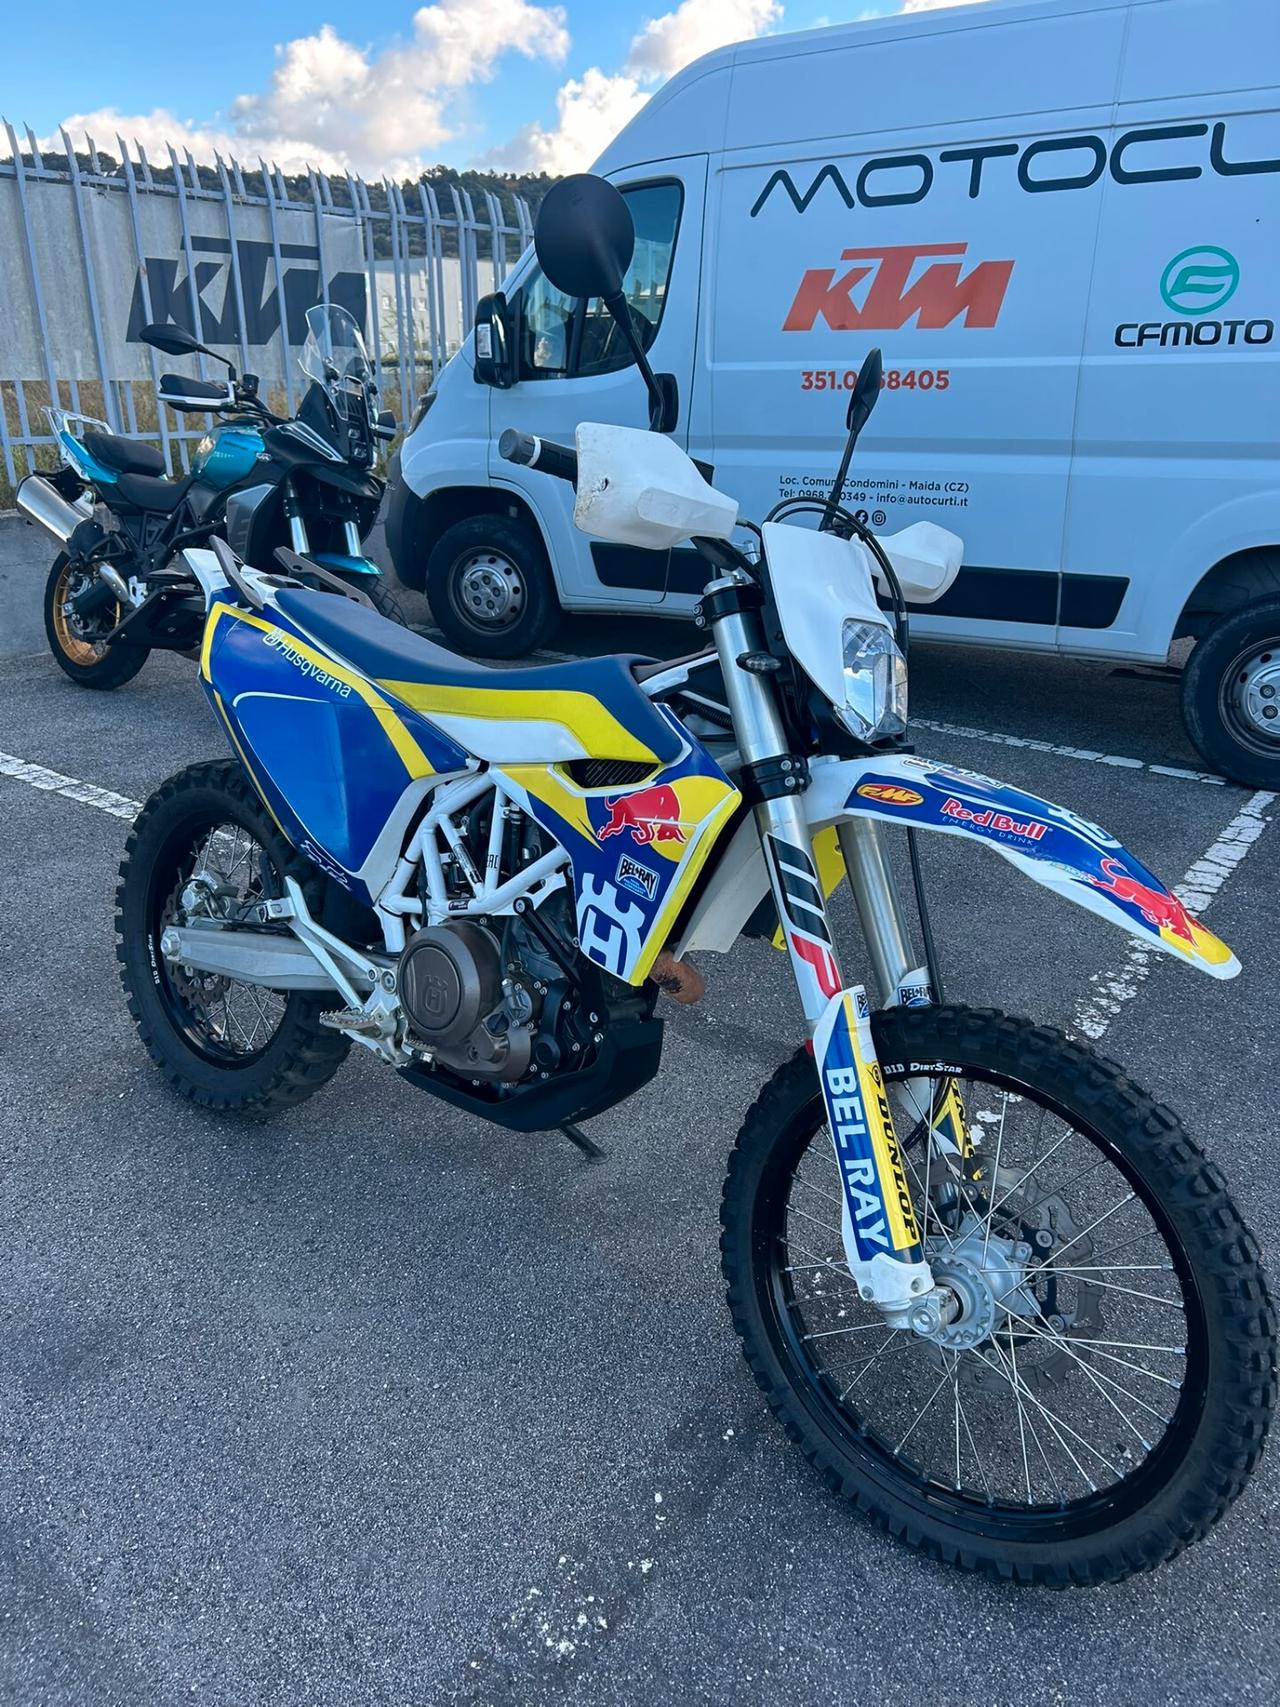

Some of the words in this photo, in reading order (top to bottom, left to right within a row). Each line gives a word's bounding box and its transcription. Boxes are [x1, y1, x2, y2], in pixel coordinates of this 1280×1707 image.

[126, 235, 366, 346] KTM
[781, 242, 1015, 331] KTM
[1114, 319, 1274, 347] CFMOTO
[801, 370, 949, 390] 351.08405
[779, 475, 799, 485] Loc.
[802, 476, 838, 487] Comun
[843, 478, 899, 489] Condomini
[909, 480, 941, 491] Maida
[944, 482, 969, 493] (CZ)
[779, 488, 795, 498] Tel:
[876, 492, 968, 506] info@autocurti.it
[275, 640, 352, 699] Husqvarna
[858, 785, 922, 803] FMF
[942, 816, 993, 835] ENERGY
[998, 831, 1034, 847] DRINK
[826, 1066, 867, 1149] BEL
[877, 1094, 917, 1240] DUNLOP
[844, 1159, 889, 1248] RAY
